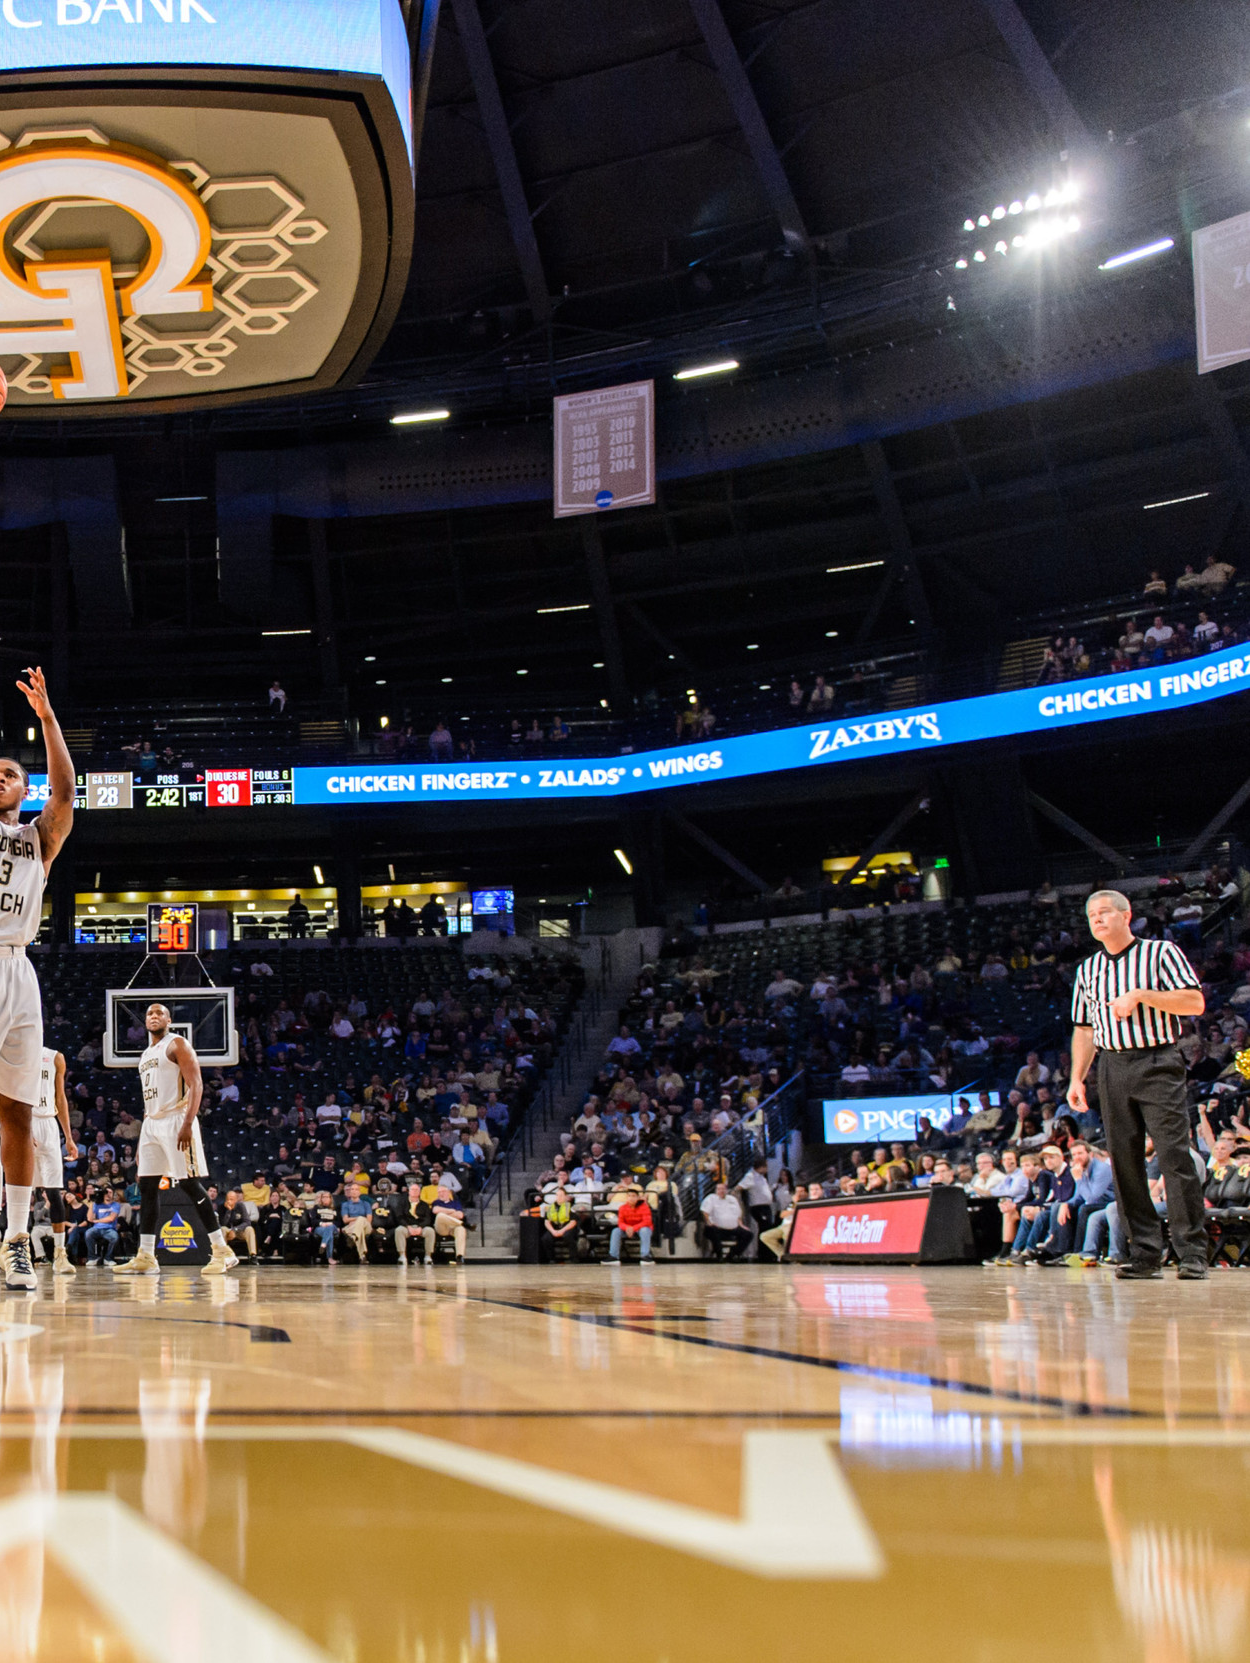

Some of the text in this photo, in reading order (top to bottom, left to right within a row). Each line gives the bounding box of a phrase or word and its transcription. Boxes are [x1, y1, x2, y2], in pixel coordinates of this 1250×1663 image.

[610, 415, 636, 432] 2010
[572, 436, 600, 452] 2003
[572, 444, 635, 466] 2007 2012
[572, 457, 636, 480] 2008 2014
[572, 477, 601, 494] 2009
[1038, 680, 1152, 717] CHICKEN
[809, 712, 942, 760] ZAXBY'S
[91, 774, 124, 785] GA TECH
[157, 775, 179, 784] POSS
[207, 771, 248, 781] DUQUESNE
[254, 770, 289, 781] FOULS 6
[326, 774, 416, 794] CHICKEN
[648, 750, 724, 778] WINGS
[97, 786, 119, 807] 28
[146, 788, 180, 807] 2:42
[188, 791, 203, 802] 1ST
[217, 783, 240, 804] 30
[161, 908, 193, 924] 2:42
[158, 923, 189, 950] 30
[144, 1088, 158, 1101] ECH
[861, 1109, 917, 1131] PNC
[163, 1229, 190, 1238] Superior
